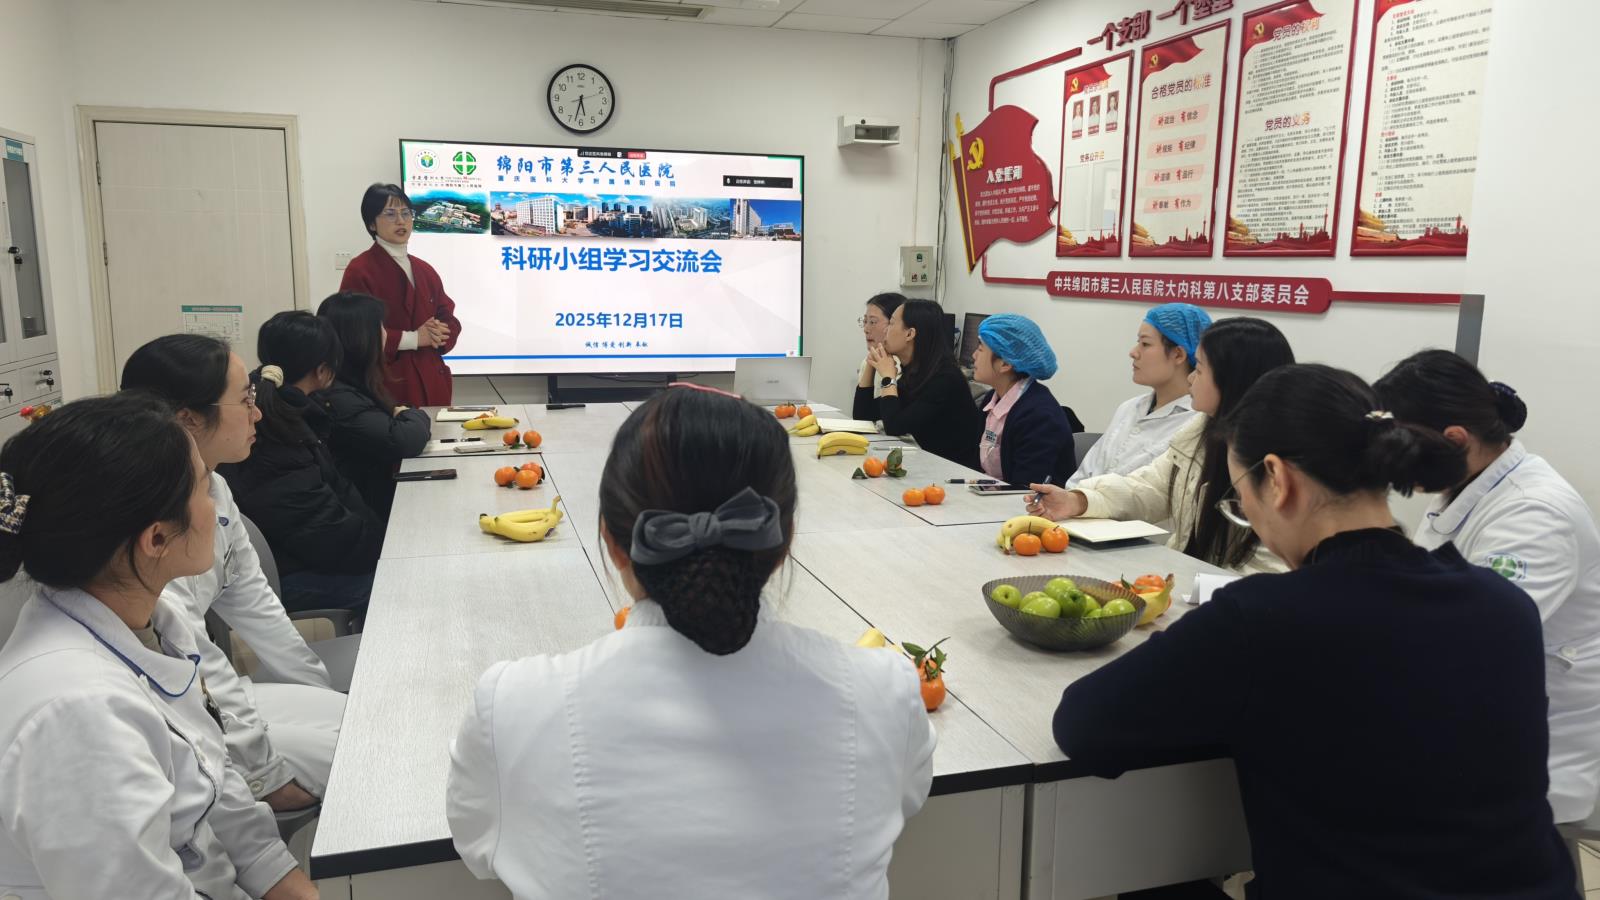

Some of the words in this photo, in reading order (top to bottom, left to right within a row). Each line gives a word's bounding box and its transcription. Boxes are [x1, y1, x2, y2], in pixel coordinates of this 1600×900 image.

[1087, 10, 1152, 51] 一个支部
[566, 75, 574, 83] 11
[577, 72, 586, 81] 12
[558, 83, 567, 92] 10
[598, 86, 604, 95] 2
[1151, 73, 1212, 100] 合格党员的标准
[554, 93, 560, 102] 9
[602, 97, 607, 105] 3
[558, 105, 564, 114] 8
[598, 108, 603, 116] 4
[567, 114, 573, 122] 7
[578, 118, 584, 127] 6
[590, 116, 596, 124] 5
[1264, 112, 1311, 132] 党员的义务
[497, 155, 675, 179] 绵阳市第三人民医院
[501, 246, 722, 273] 科研小组学习交流会
[1054, 276, 1310, 306] 中共绵阳市第三人民医院大内科第八支部委员会
[555, 312, 684, 329] 2025年12月17日
